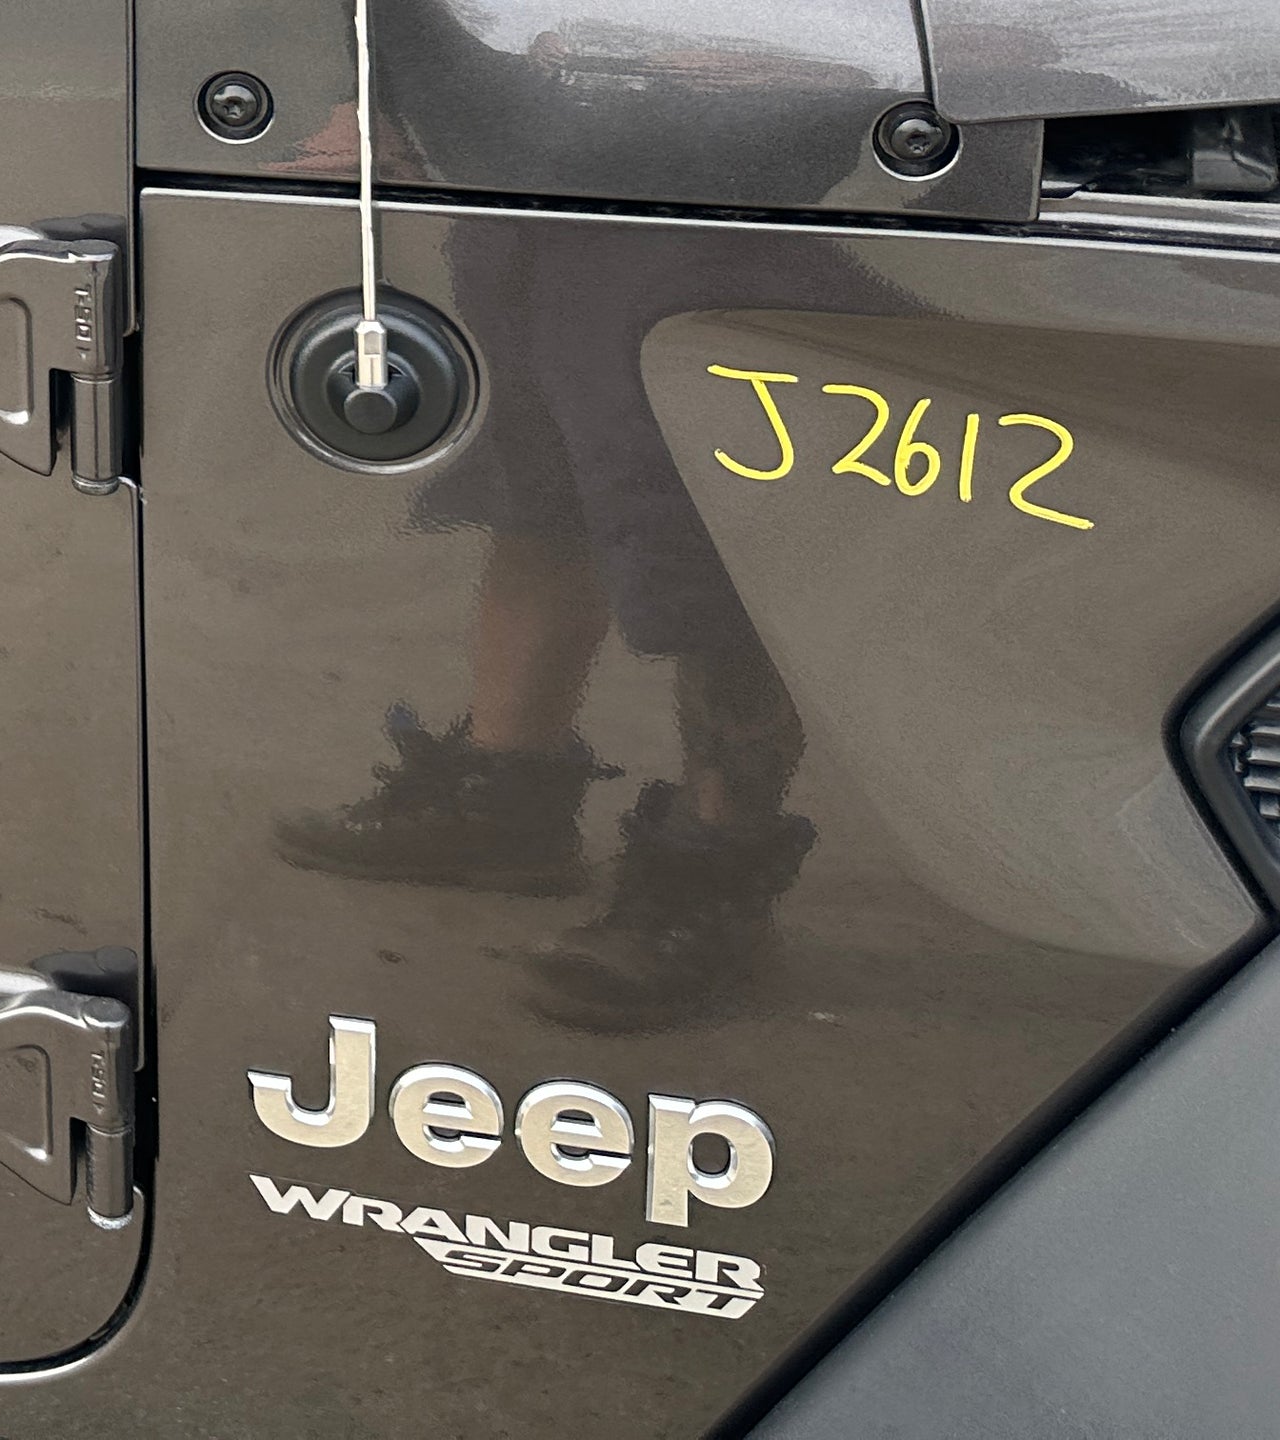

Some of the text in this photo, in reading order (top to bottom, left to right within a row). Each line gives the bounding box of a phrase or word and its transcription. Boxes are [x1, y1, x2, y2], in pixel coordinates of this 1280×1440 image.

[707, 364, 1095, 530] J2612
[247, 1013, 777, 1228] Jeep
[249, 1174, 766, 1294] WRANGLER
[443, 1247, 756, 1314] SPORT
